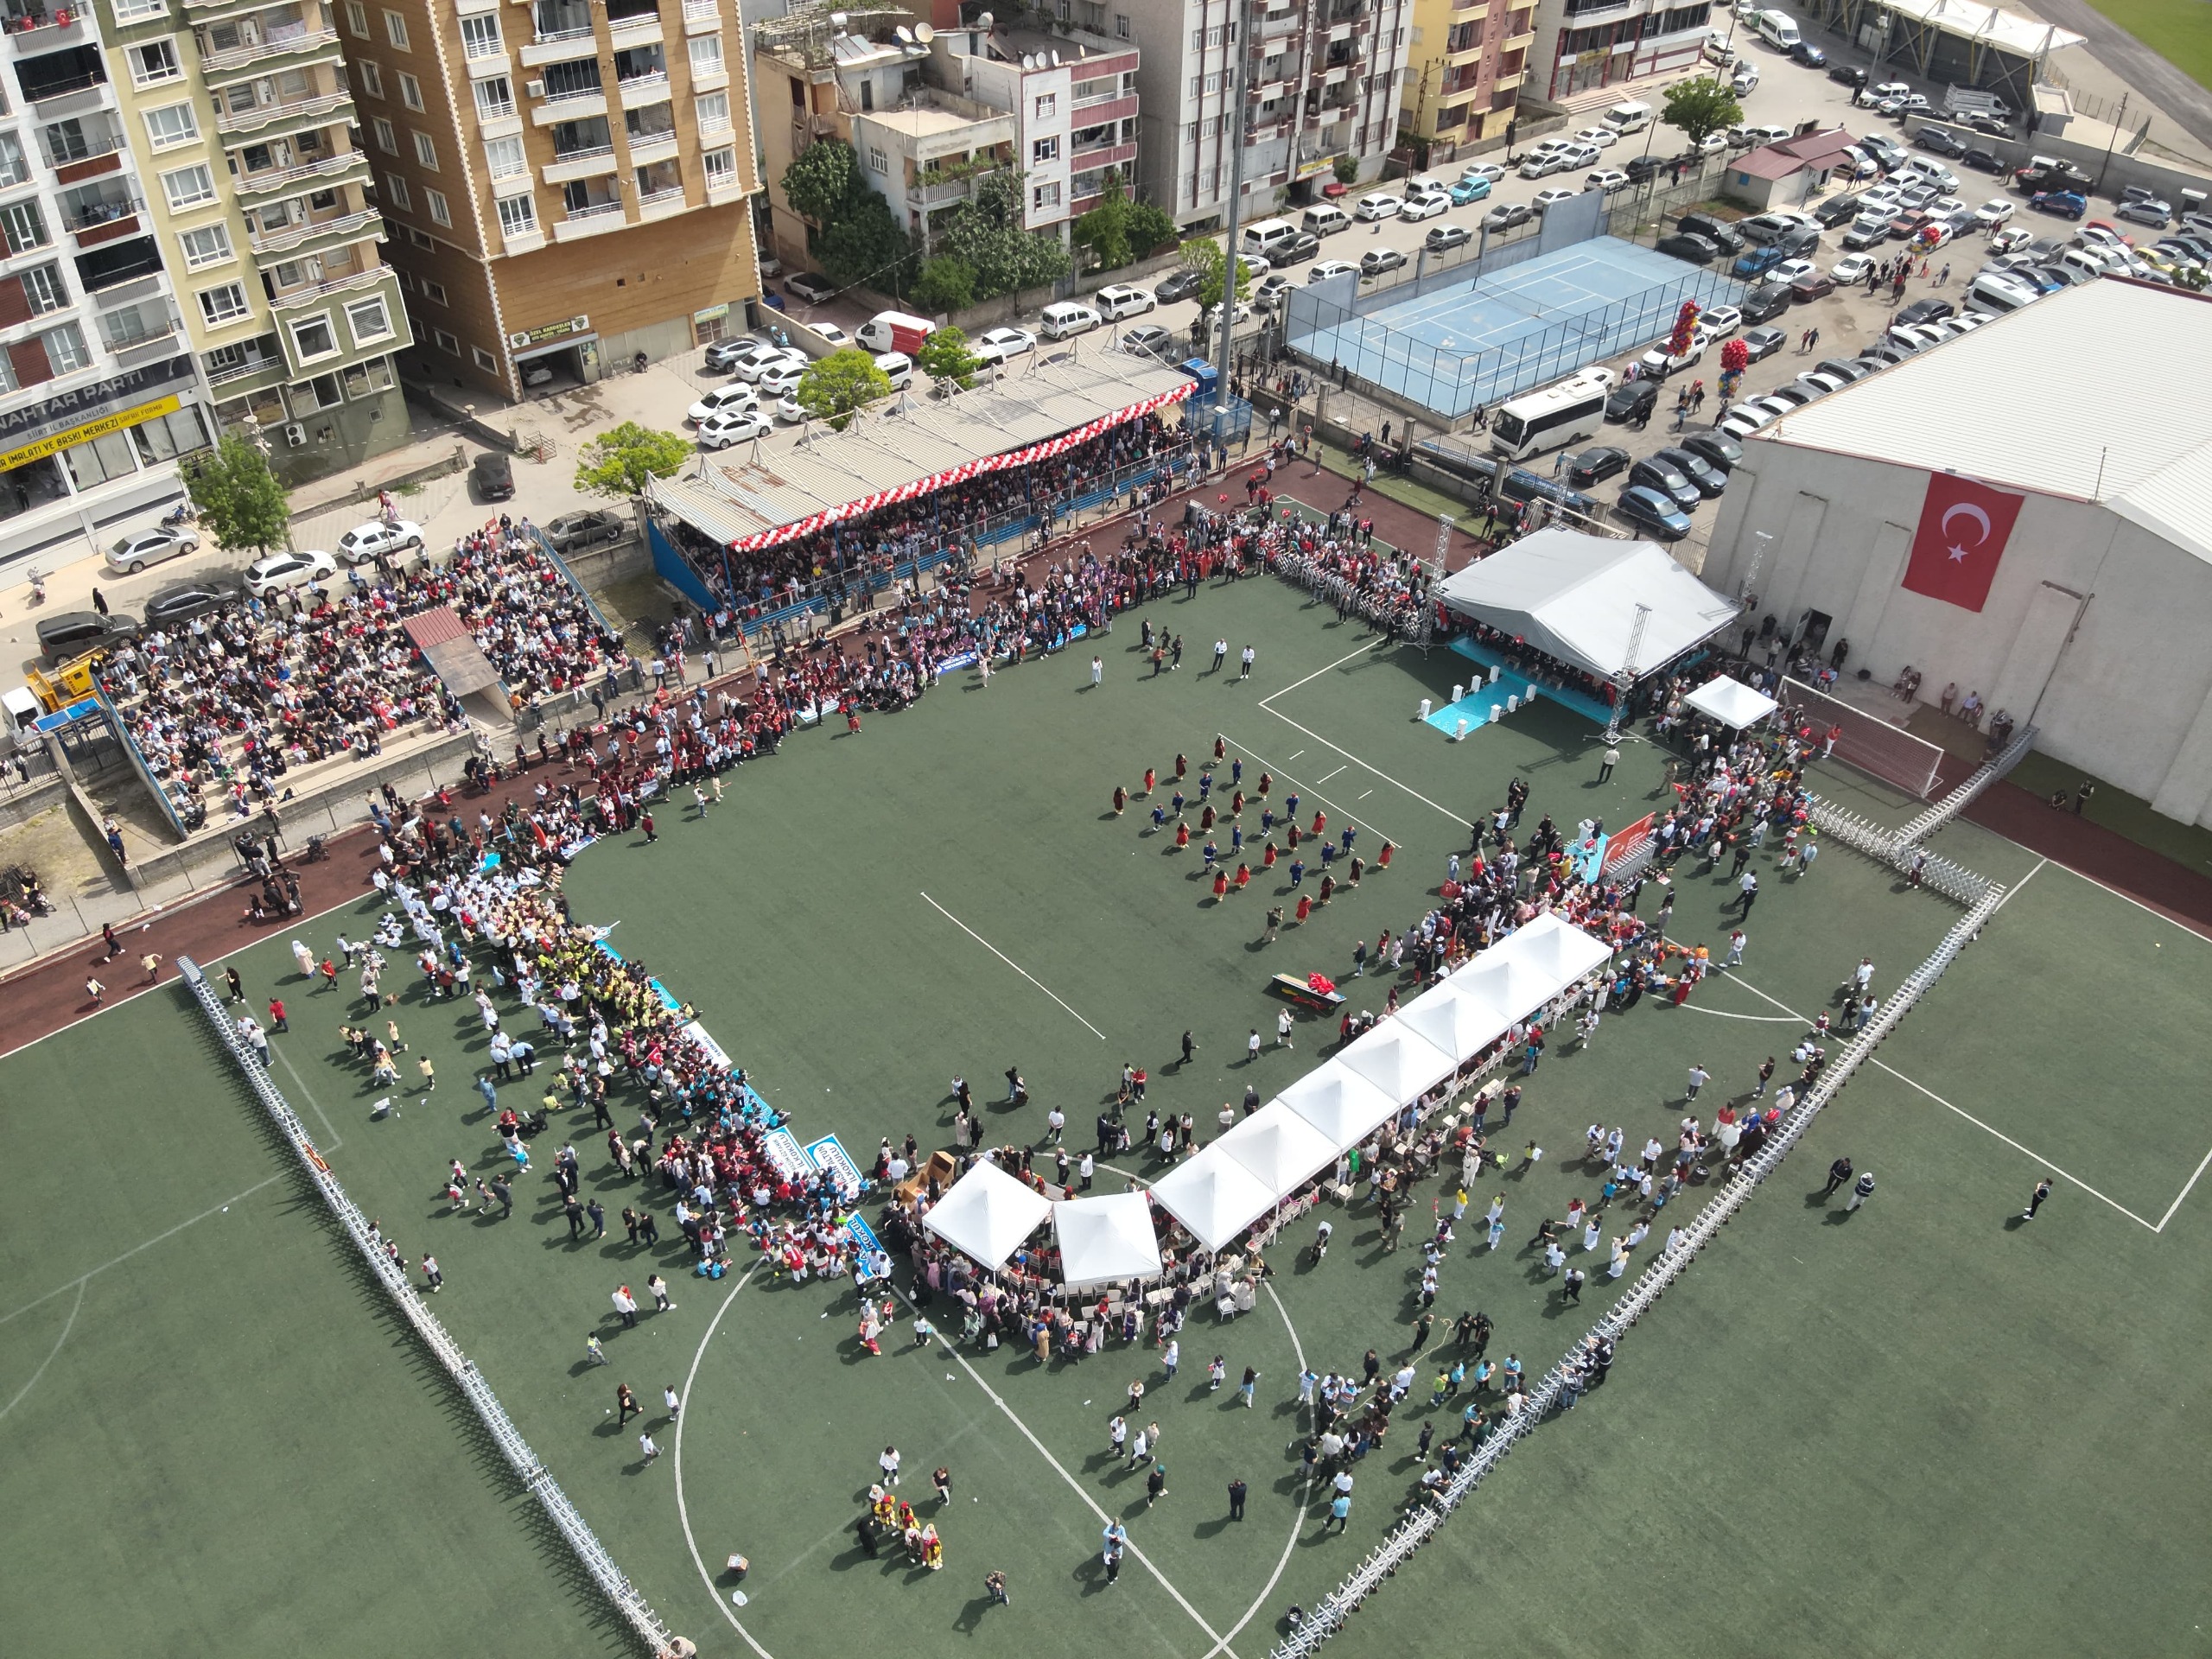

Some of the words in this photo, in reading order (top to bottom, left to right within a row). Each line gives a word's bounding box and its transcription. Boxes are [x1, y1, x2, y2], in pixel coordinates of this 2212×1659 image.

[58, 406, 109, 429] BAŞKANLIĞI
[8, 445, 41, 465] İMALATI
[42, 441, 54, 451] VE
[56, 430, 81, 447] BASKI
[82, 417, 119, 438] MERKEZİ
[779, 1134, 805, 1170] İLKOKULU
[817, 1146, 835, 1166] ALTUN
[830, 1147, 857, 1184] İLKOKULU
